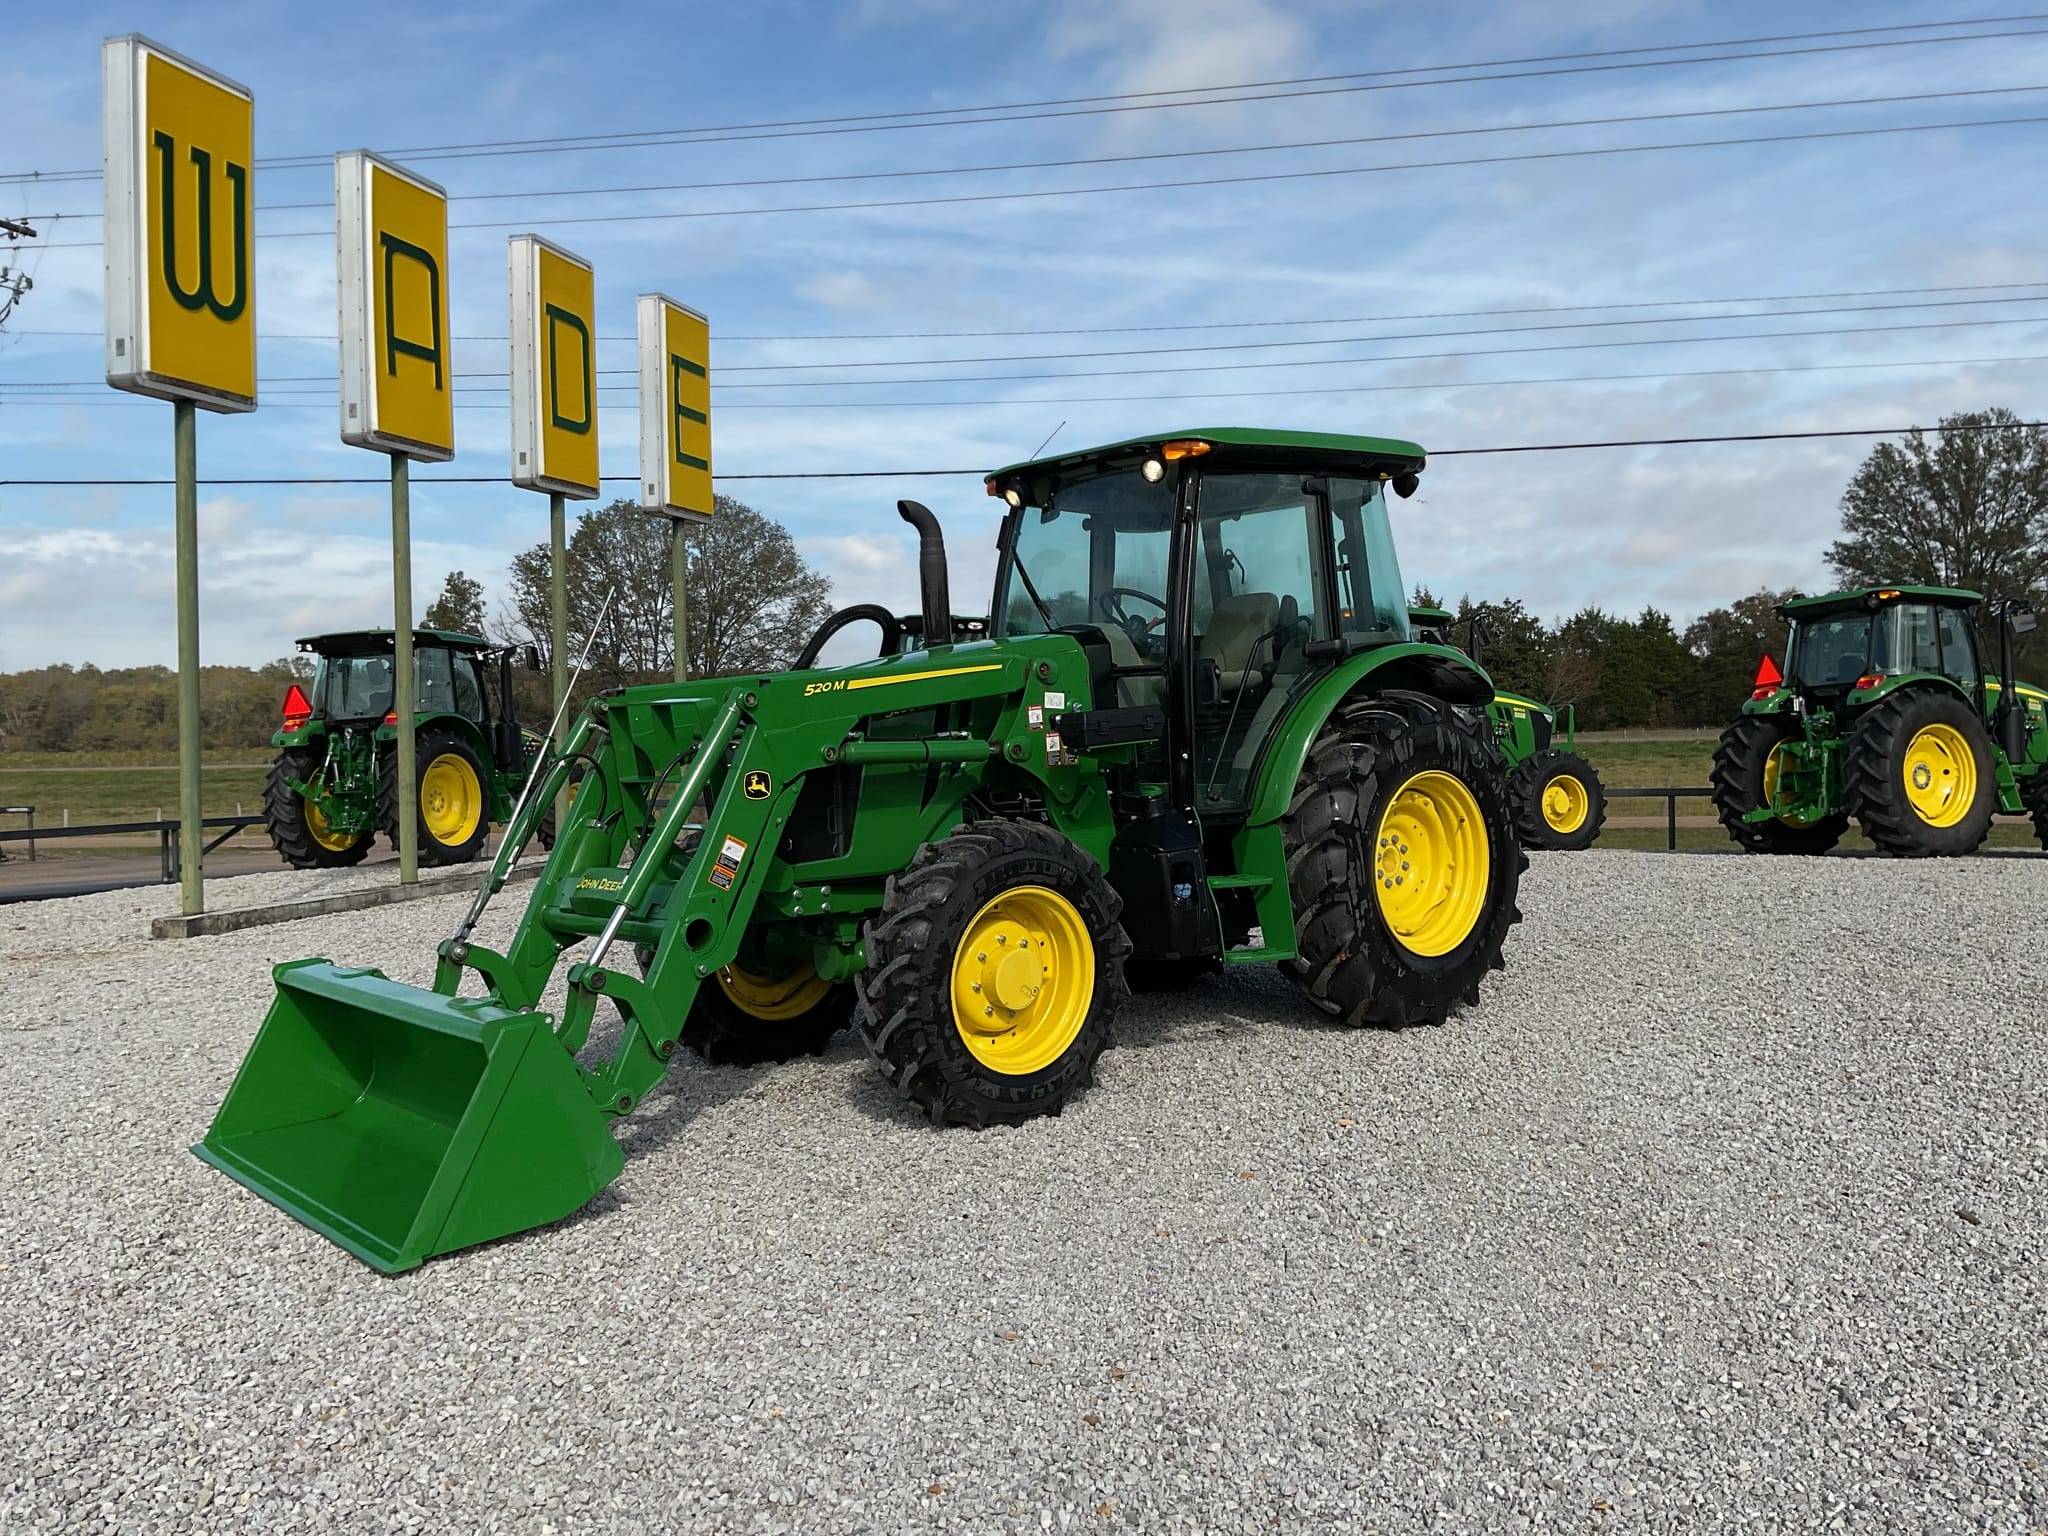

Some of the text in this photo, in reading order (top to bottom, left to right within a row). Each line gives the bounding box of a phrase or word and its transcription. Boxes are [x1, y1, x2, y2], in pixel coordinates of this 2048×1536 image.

[804, 680, 846, 697] 520 M
[576, 877, 624, 891] JOHN DEER
